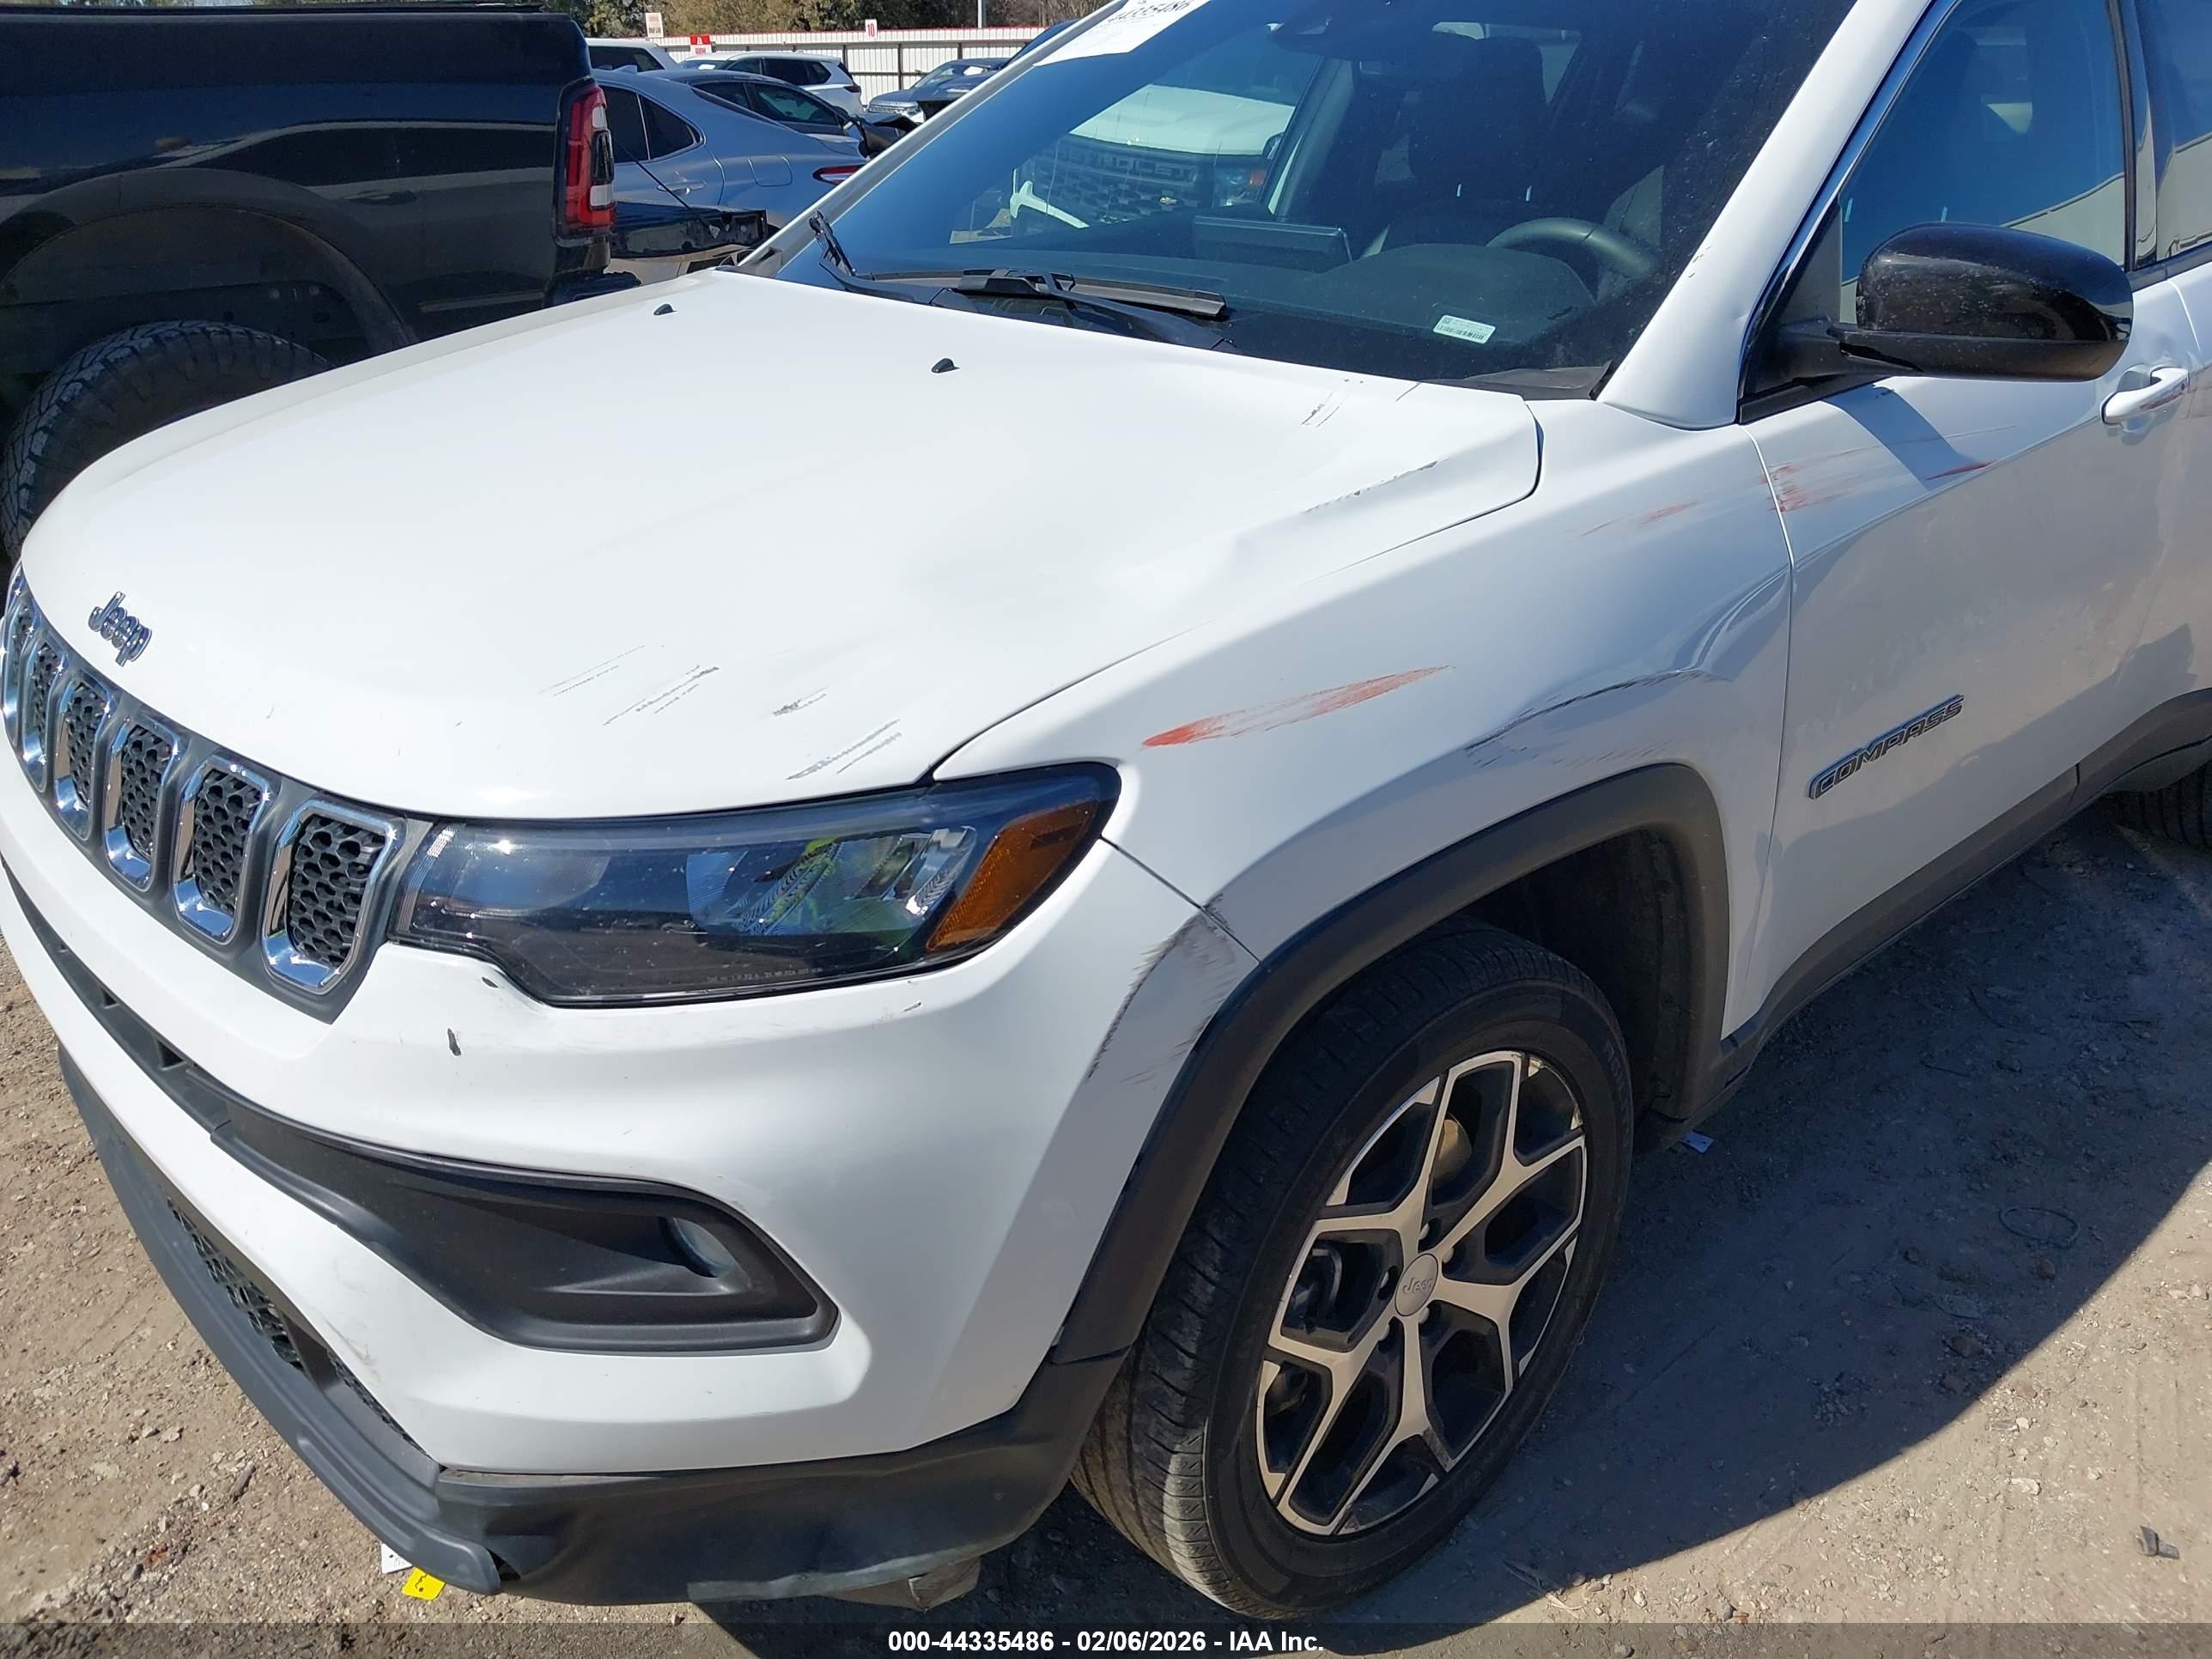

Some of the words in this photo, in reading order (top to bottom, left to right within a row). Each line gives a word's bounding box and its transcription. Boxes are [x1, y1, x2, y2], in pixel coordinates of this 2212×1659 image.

[867, 23, 875, 38] 10
[88, 591, 153, 667] Jeep
[1808, 694, 1965, 799] COMPASS
